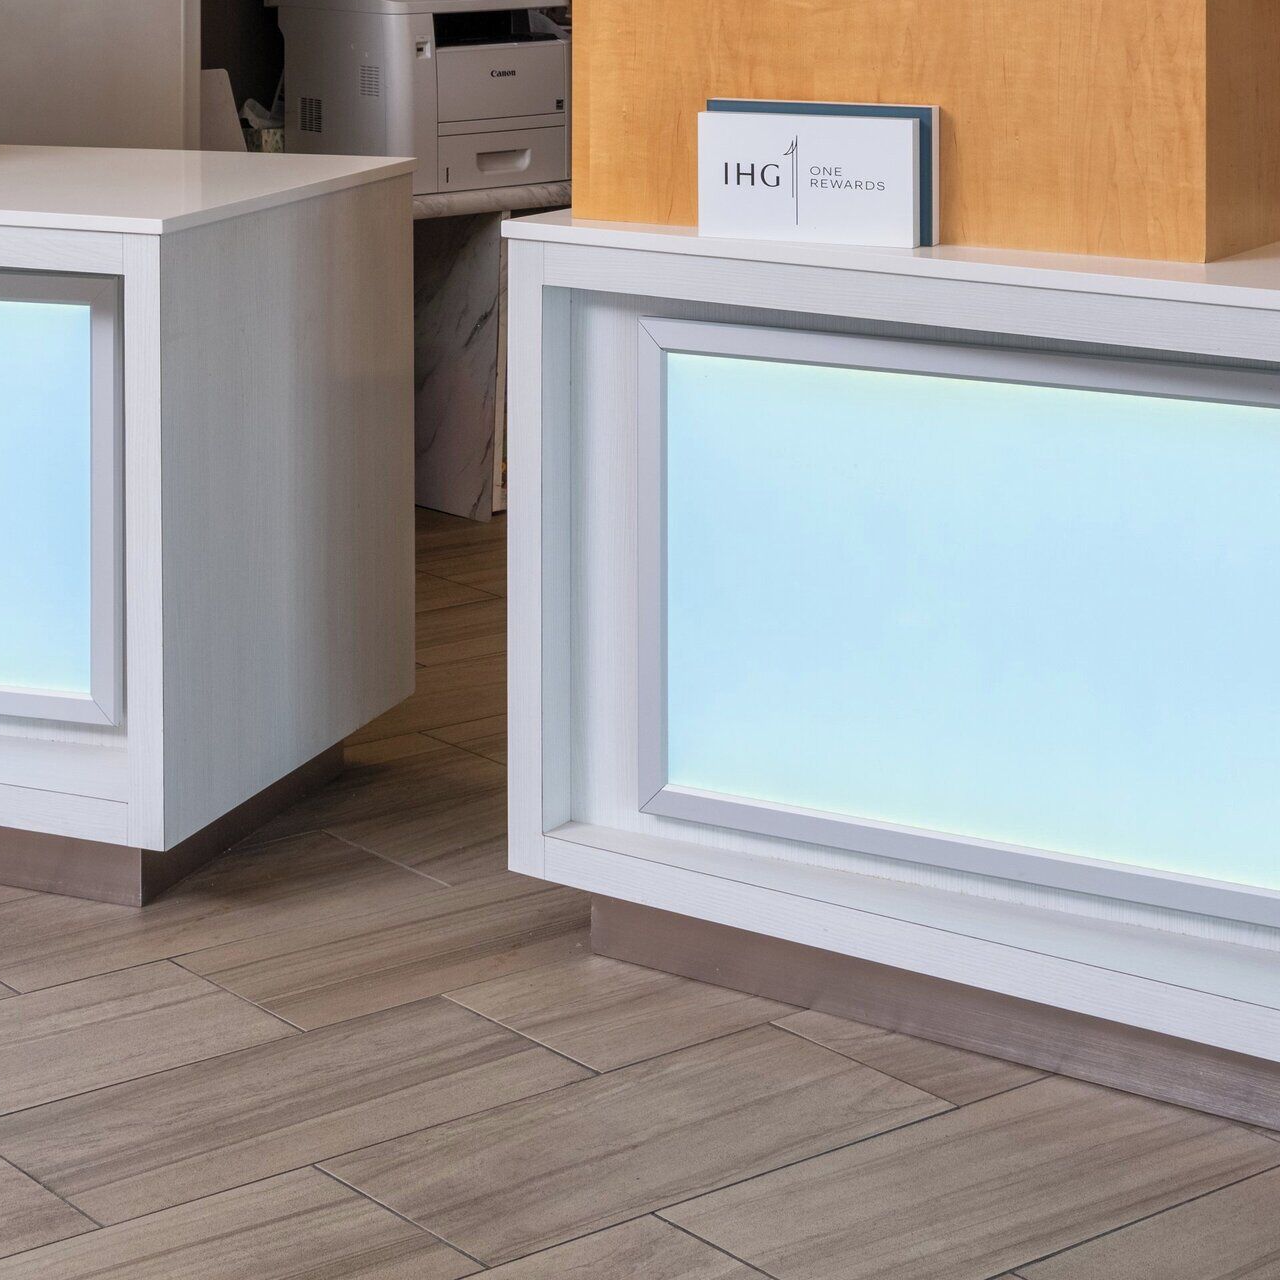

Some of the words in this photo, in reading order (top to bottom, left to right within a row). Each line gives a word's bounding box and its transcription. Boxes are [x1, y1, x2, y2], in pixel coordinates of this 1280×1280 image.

[490, 70, 516, 78] Canon
[724, 162, 780, 188] IHG
[809, 165, 842, 177] ONE
[809, 178, 886, 191] REWARDS
